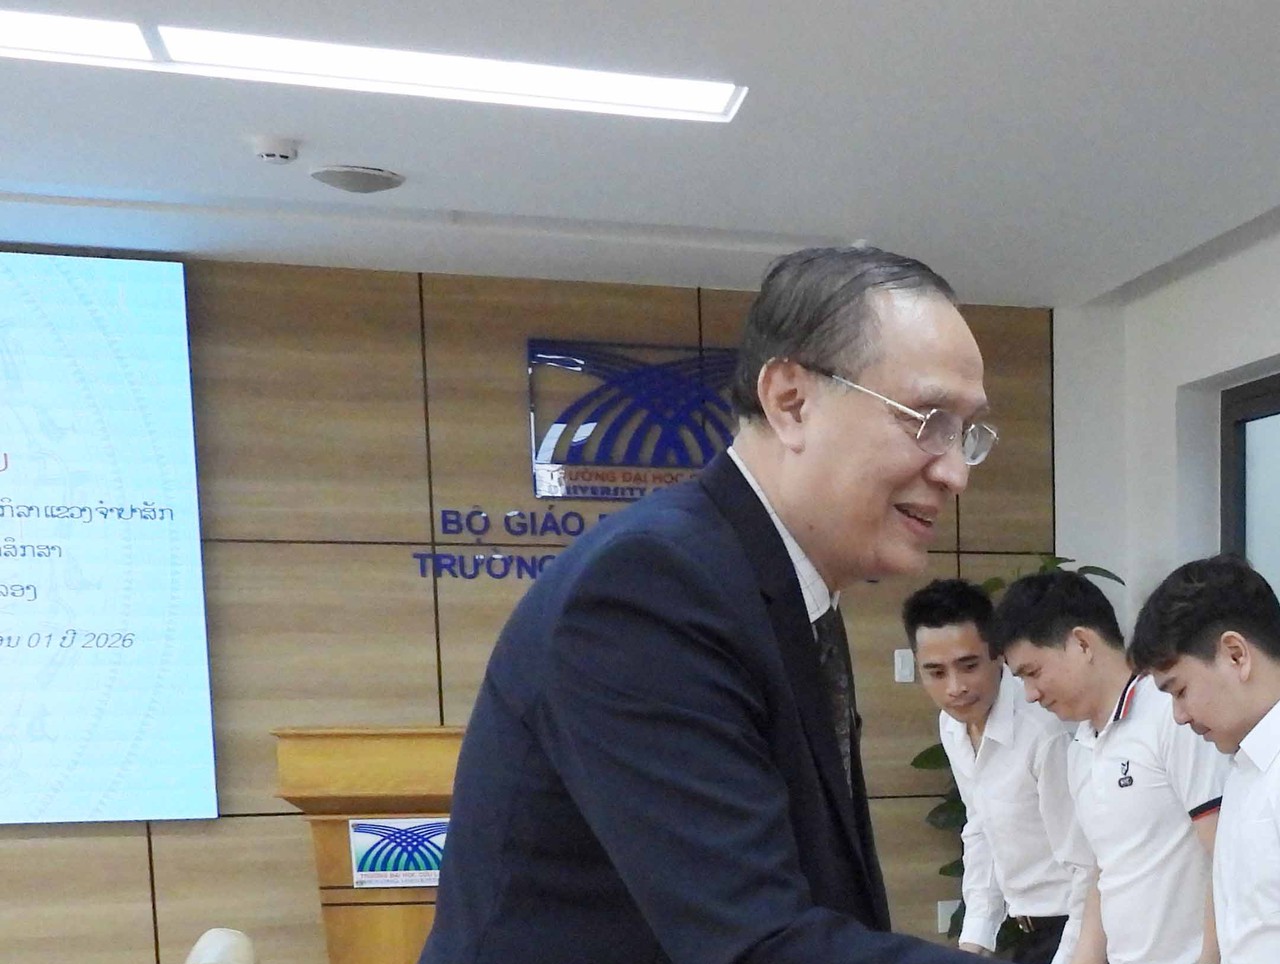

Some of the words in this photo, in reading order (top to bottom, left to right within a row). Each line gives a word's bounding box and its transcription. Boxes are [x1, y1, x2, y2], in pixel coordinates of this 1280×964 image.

[440, 505, 490, 543] BỘ
[504, 504, 584, 536] GIÁO
[27, 632, 52, 648] 01
[82, 632, 135, 648] 2026
